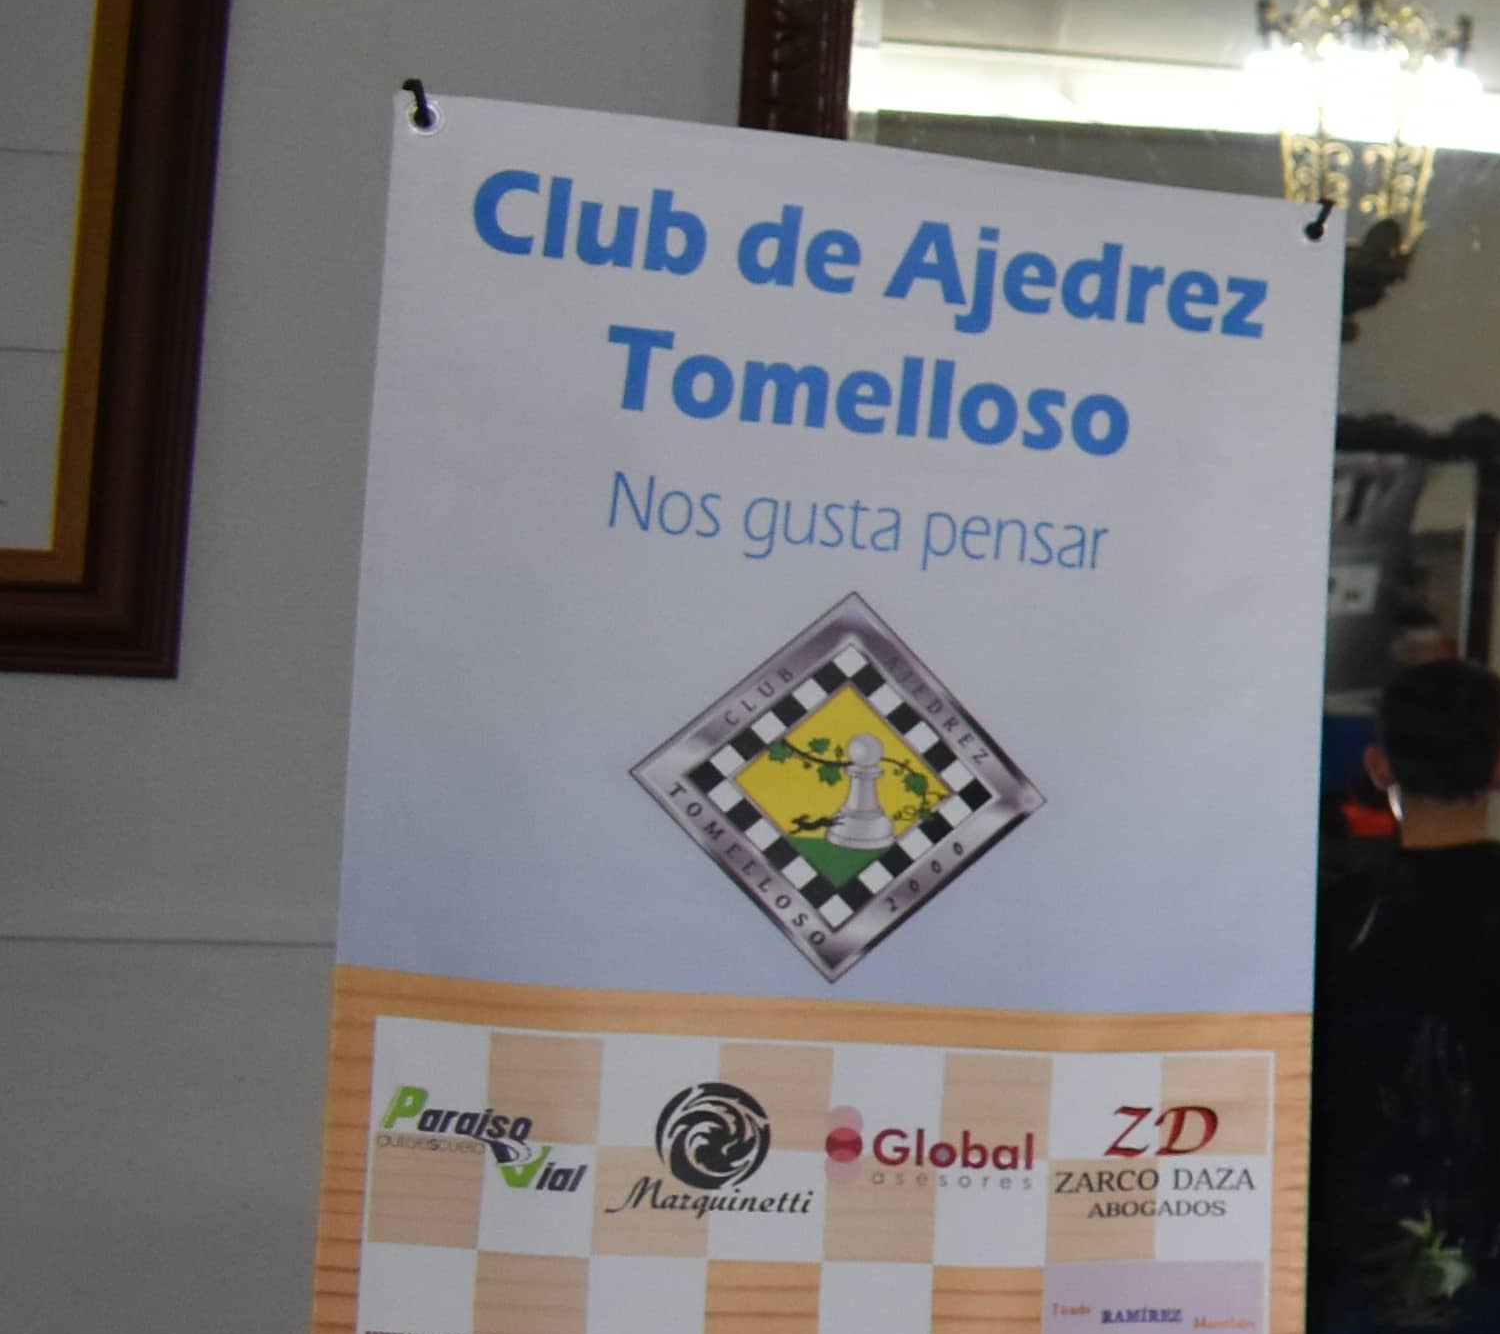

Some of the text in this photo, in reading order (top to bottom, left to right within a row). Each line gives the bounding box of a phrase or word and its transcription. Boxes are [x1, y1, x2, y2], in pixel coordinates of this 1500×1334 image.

[473, 169, 1269, 338] Club de Ajedrez
[606, 324, 1130, 457] Tomelloso
[607, 470, 1109, 571] Nos gusta pensar
[723, 667, 794, 727] CLUB
[668, 782, 827, 948] TOMELLOSO
[885, 840, 965, 913] 2000
[873, 1128, 1034, 1172] Global
[1104, 1104, 1219, 1157] ZD
[499, 1145, 588, 1192] Vial
[871, 1172, 1034, 1191] asesores
[1054, 1168, 1256, 1195] ZARCO DAZA
[604, 1176, 815, 1219] Marquinetti
[1088, 1199, 1226, 1220] ABOGADOS
